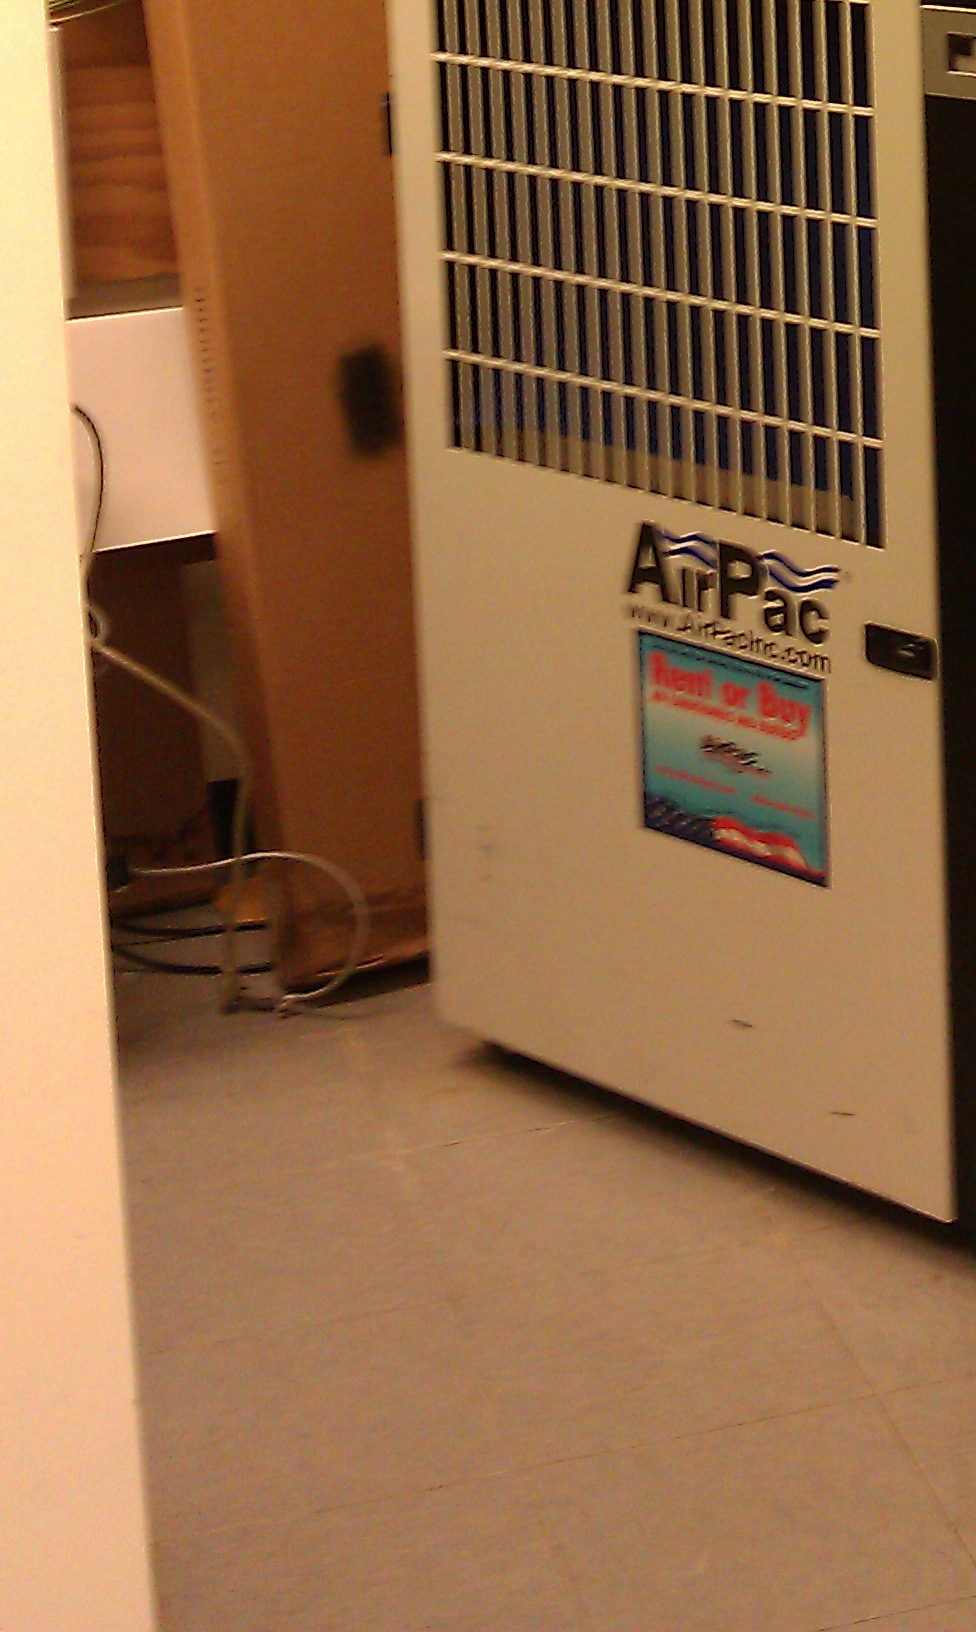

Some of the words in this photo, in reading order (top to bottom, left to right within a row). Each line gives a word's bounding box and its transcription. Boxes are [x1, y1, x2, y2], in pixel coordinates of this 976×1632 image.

[627, 520, 831, 646] AirPac
[648, 651, 714, 699] Rent
[719, 681, 751, 709] or
[758, 681, 812, 733] Buy
